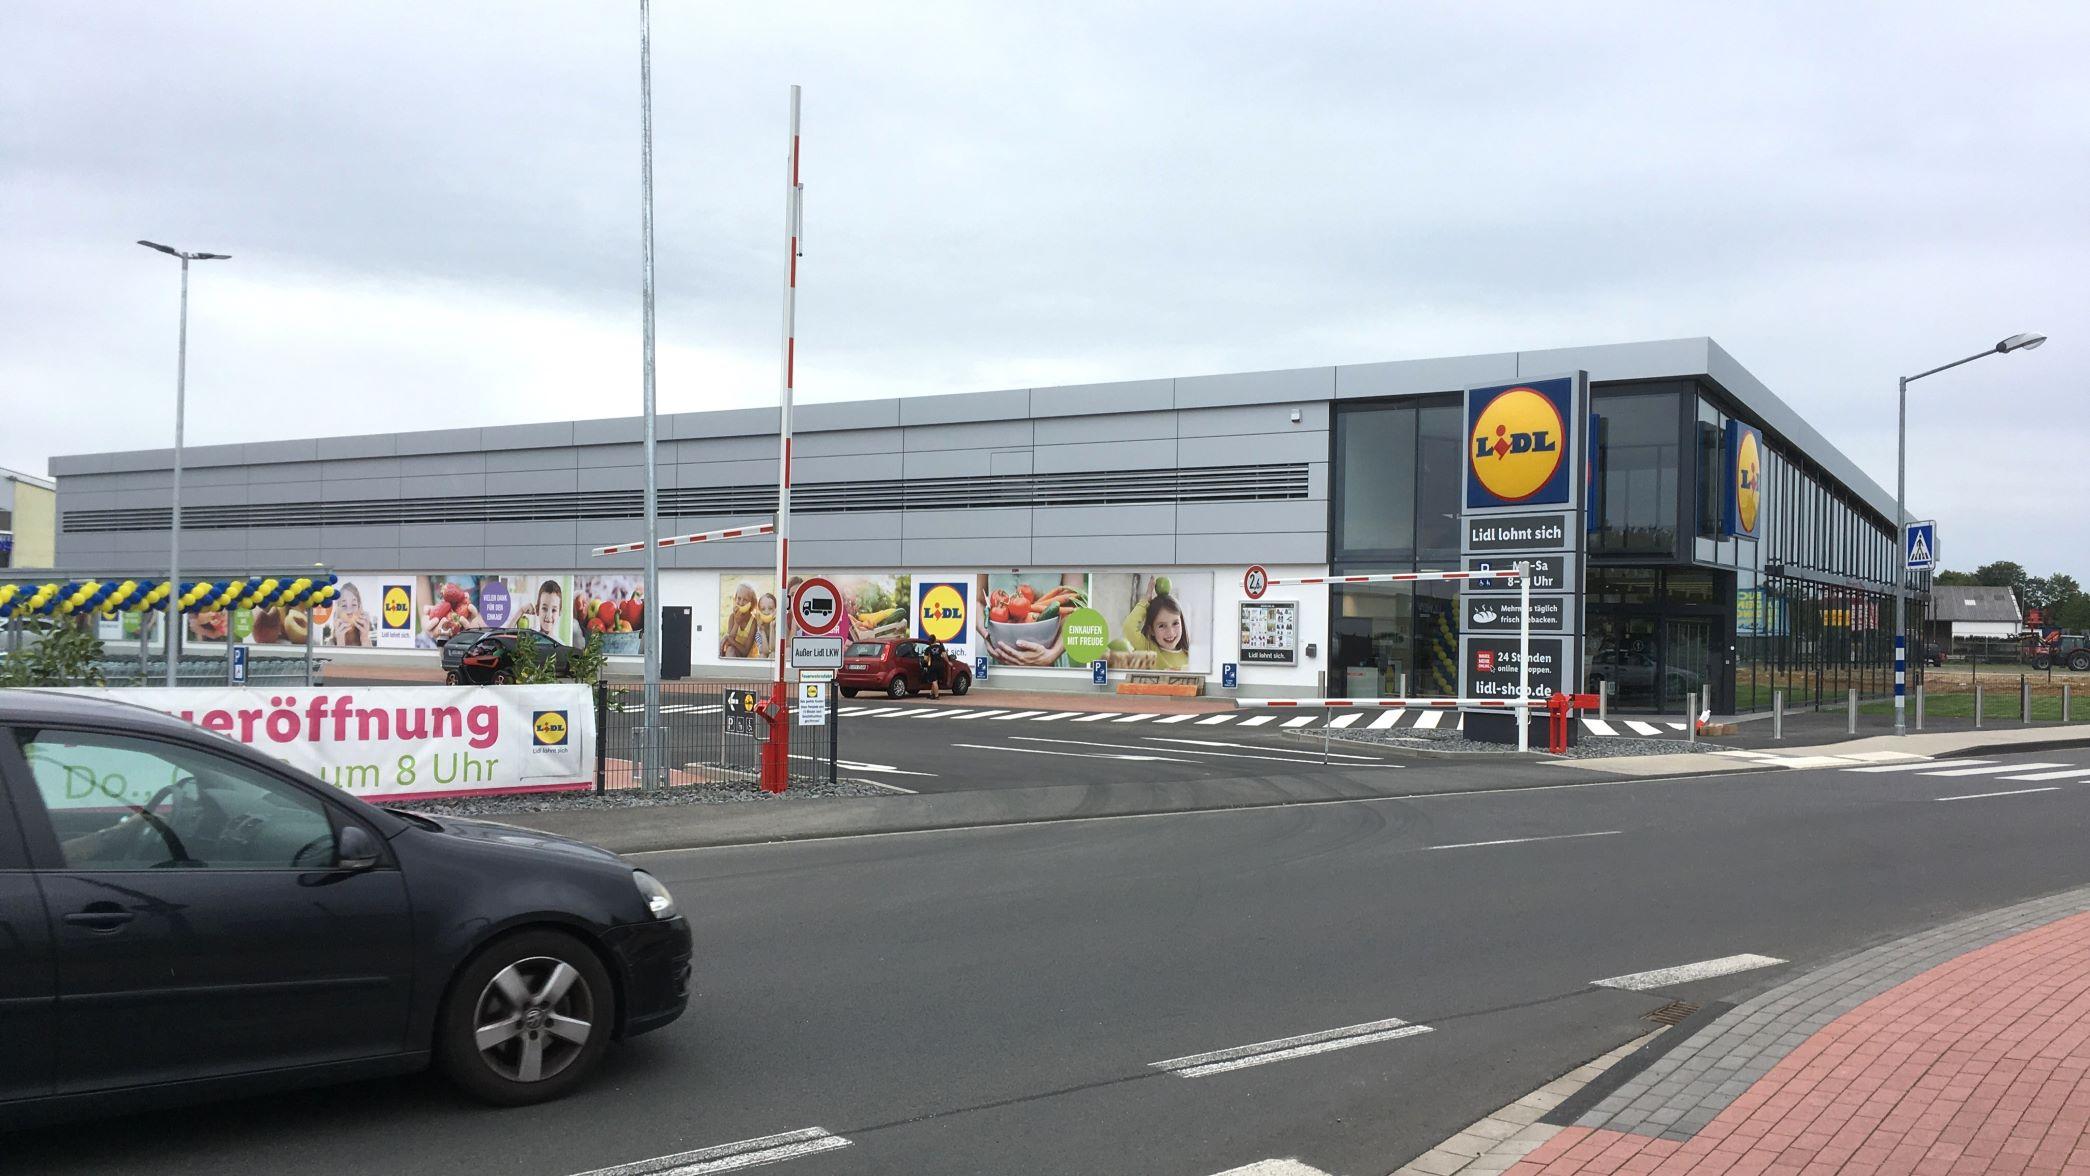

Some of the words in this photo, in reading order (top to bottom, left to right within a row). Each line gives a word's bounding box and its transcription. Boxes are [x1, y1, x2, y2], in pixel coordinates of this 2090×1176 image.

[1475, 424, 1556, 461] LIDL
[1472, 528, 1496, 542] Lidl
[1498, 527, 1532, 541] lohnt
[1534, 525, 1561, 539] sich
[1533, 575, 1554, 586] Uhr
[385, 600, 408, 613] LIDL
[924, 602, 962, 621] LIDL
[1534, 604, 1558, 614] täglich
[1500, 615, 1520, 624] frisch
[1528, 616, 1558, 624] ebacken.
[1069, 625, 1102, 635] EINKAUFEN
[1067, 636, 1079, 646] MIT
[1079, 637, 1104, 646] FREUDE
[795, 648, 813, 657] Außer
[814, 648, 825, 657] Lidl
[826, 648, 840, 657] LKW
[1248, 651, 1259, 660] Lidl
[1259, 651, 1273, 660] lohnt
[1497, 652, 1510, 662] 24
[1511, 652, 1552, 663] Stnden
[1497, 664, 1519, 673] online
[536, 721, 565, 733] LIDL
[396, 754, 416, 786] 8
[433, 751, 499, 784] Uhr
